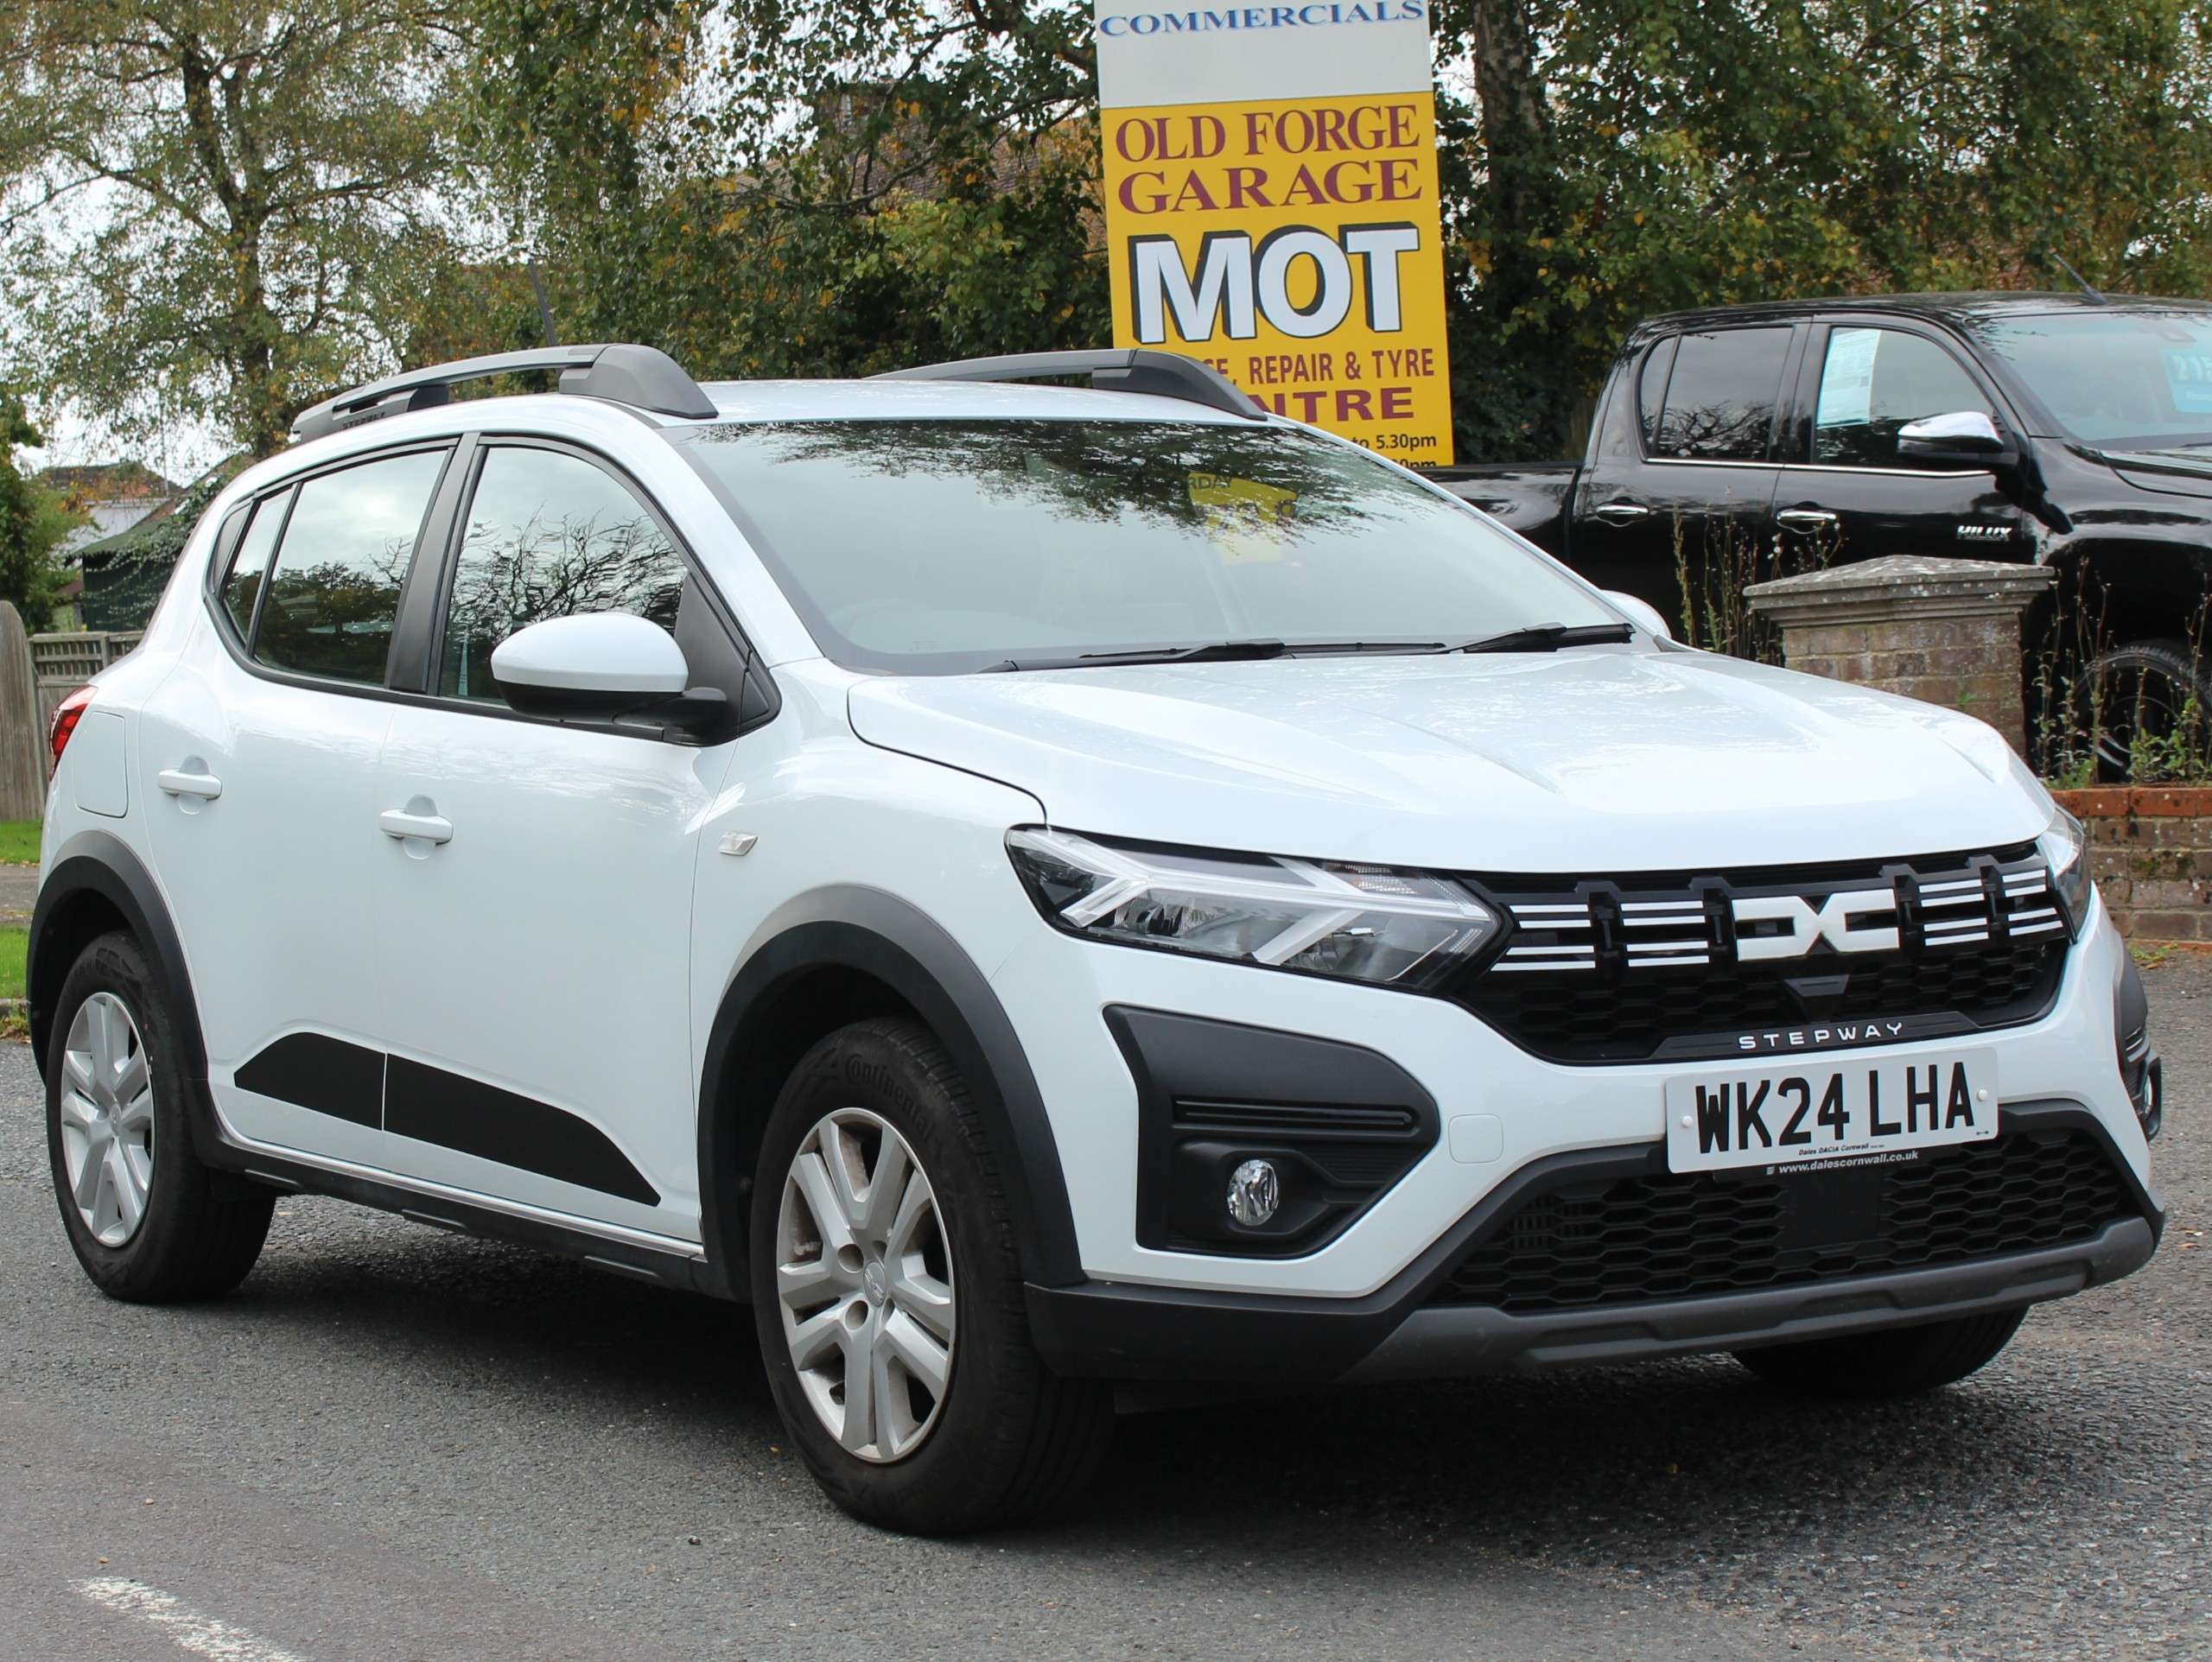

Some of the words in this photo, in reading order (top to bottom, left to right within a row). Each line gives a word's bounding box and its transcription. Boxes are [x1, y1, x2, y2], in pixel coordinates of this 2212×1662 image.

[1099, 0, 1424, 36] COMMERCIALS
[1116, 114, 1225, 162] OLD
[1242, 104, 1420, 155] FORGE
[1118, 158, 1422, 214] GARAGE
[1128, 221, 1420, 344] MOT
[1249, 353, 1333, 384] REPAIR
[1345, 352, 1361, 380] &
[1371, 348, 1434, 378] TYRE
[1376, 433, 1437, 452] 5.30pm
[1956, 524, 2013, 542] HILUX
[1738, 1022, 1904, 1050] STEPWAY
[1695, 1072, 1850, 1154] WK24
[1869, 1062, 1975, 1139] LHA
[1778, 1150, 1919, 1175] www.dalescornwall.co.uk
